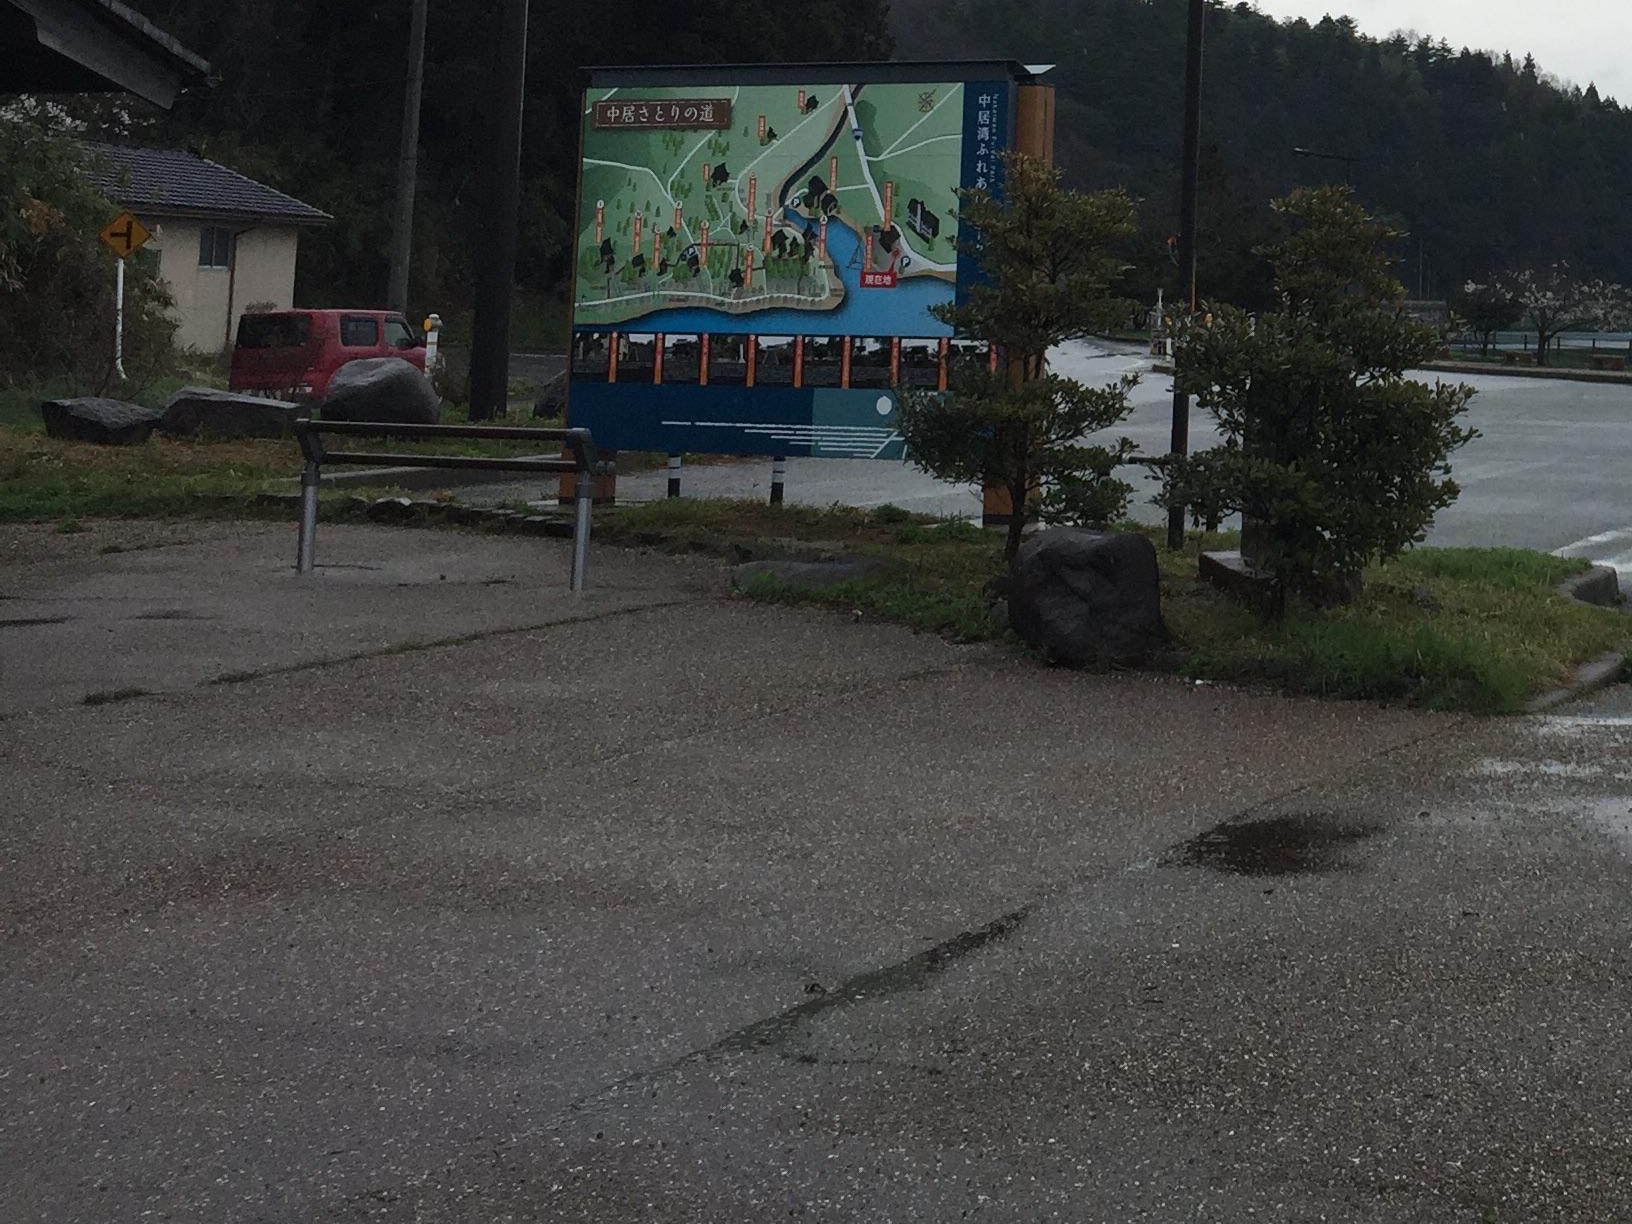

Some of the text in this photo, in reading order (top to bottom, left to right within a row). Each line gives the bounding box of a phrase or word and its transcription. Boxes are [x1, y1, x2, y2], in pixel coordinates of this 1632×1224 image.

[607, 105, 714, 123] 中居さとりの道
[864, 274, 892, 285] 現在地
